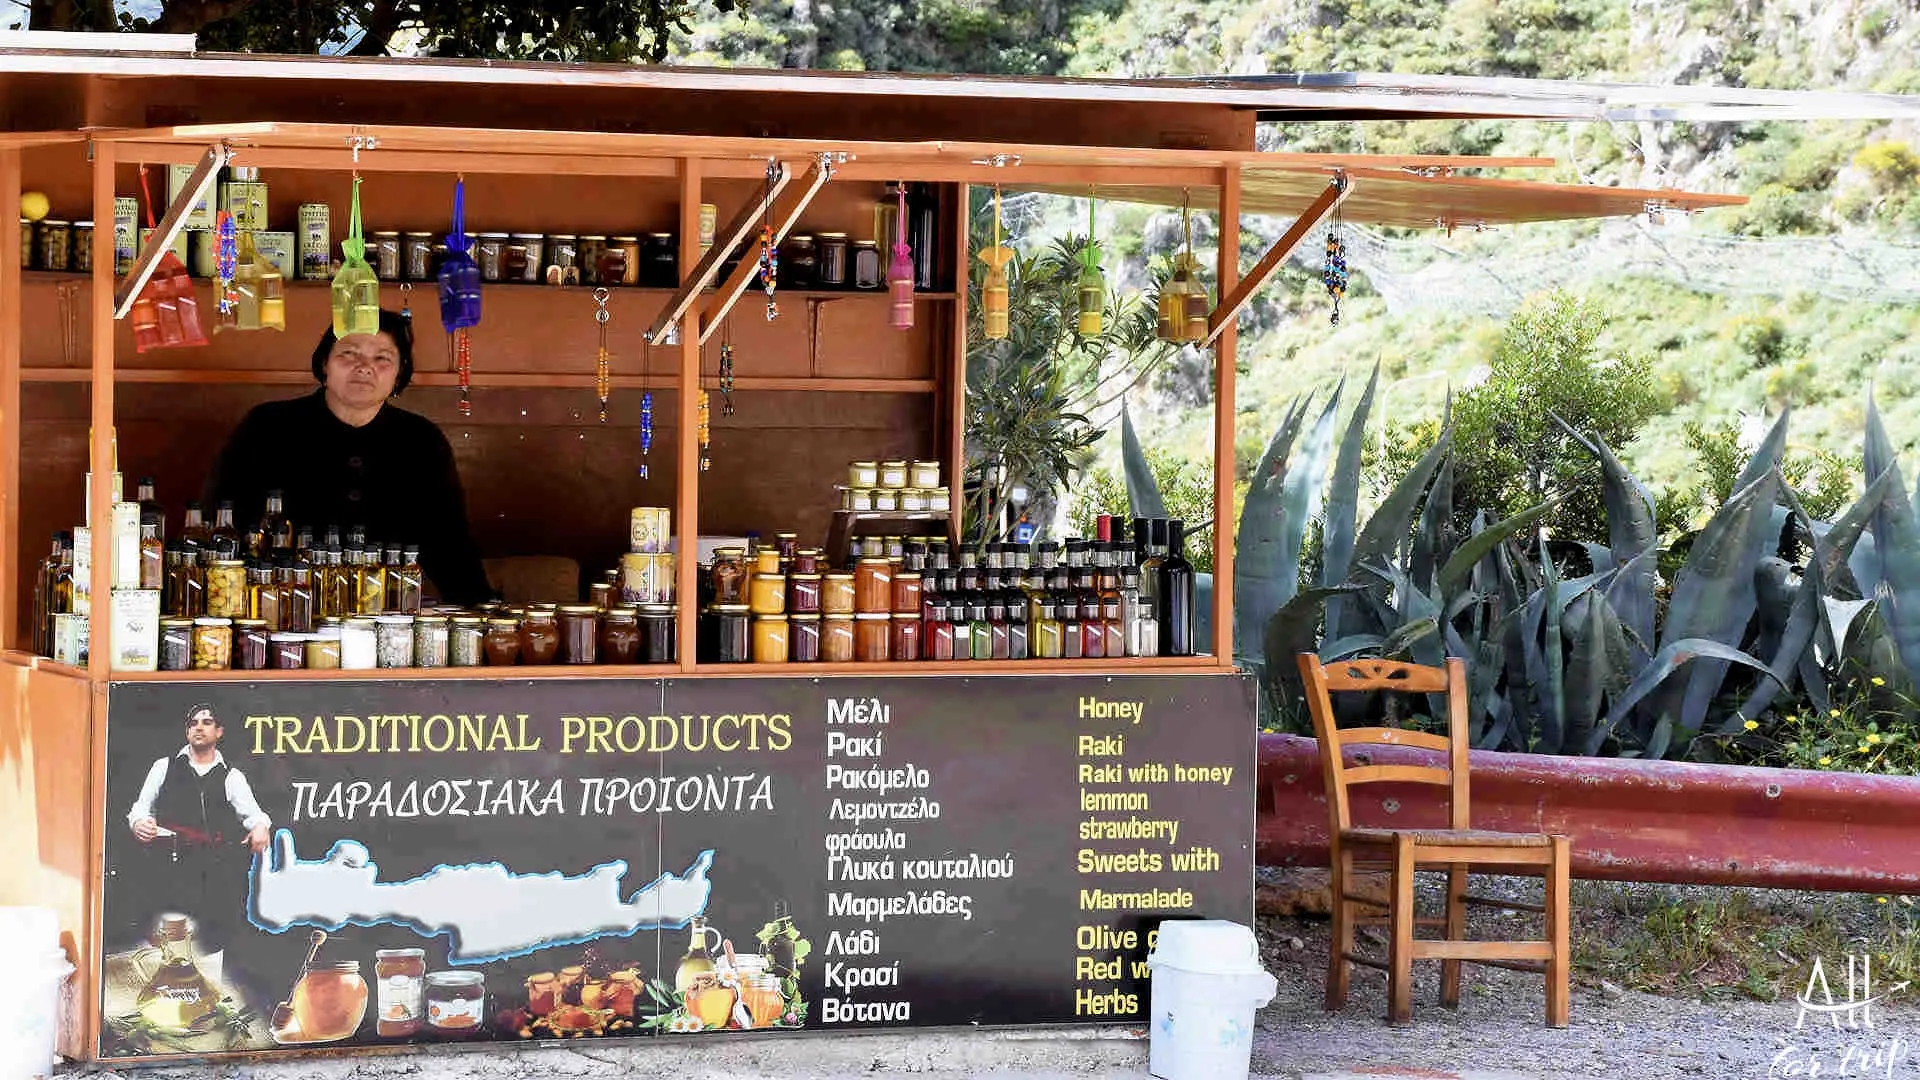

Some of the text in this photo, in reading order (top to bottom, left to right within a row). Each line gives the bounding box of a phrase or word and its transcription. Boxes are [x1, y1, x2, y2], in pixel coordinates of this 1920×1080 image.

[827, 697, 890, 724] Μέλι
[1079, 696, 1144, 725] Honey
[244, 714, 792, 754] TRADITIONAL PRODUCTS
[827, 730, 882, 757] Ρακί
[1078, 734, 1123, 756] Raki
[826, 763, 930, 796] Ρακόμελο
[1078, 763, 1233, 786] Raki with honey
[291, 772, 774, 822] ΠΑΡΑΔΟΣΙΑΚΑ ΠΡΟΙΟΝΤΑ
[1080, 787, 1149, 812] lemmon
[829, 796, 940, 826] Λεμοντζέλο
[825, 827, 906, 858] φράουλα
[1079, 815, 1179, 845] strawberry
[827, 852, 1014, 881] Γλυκά κουταλιού
[1077, 846, 1220, 873] Sweets with
[828, 890, 973, 923] Μαρμελάδες
[1080, 887, 1193, 910] Marmalade
[824, 929, 880, 956] Λάδι
[1076, 924, 1138, 950] Olive
[824, 960, 900, 993] Κρασί
[1076, 956, 1122, 981] Red
[822, 997, 910, 1023] Βότανα
[1075, 988, 1138, 1016] Herbs
